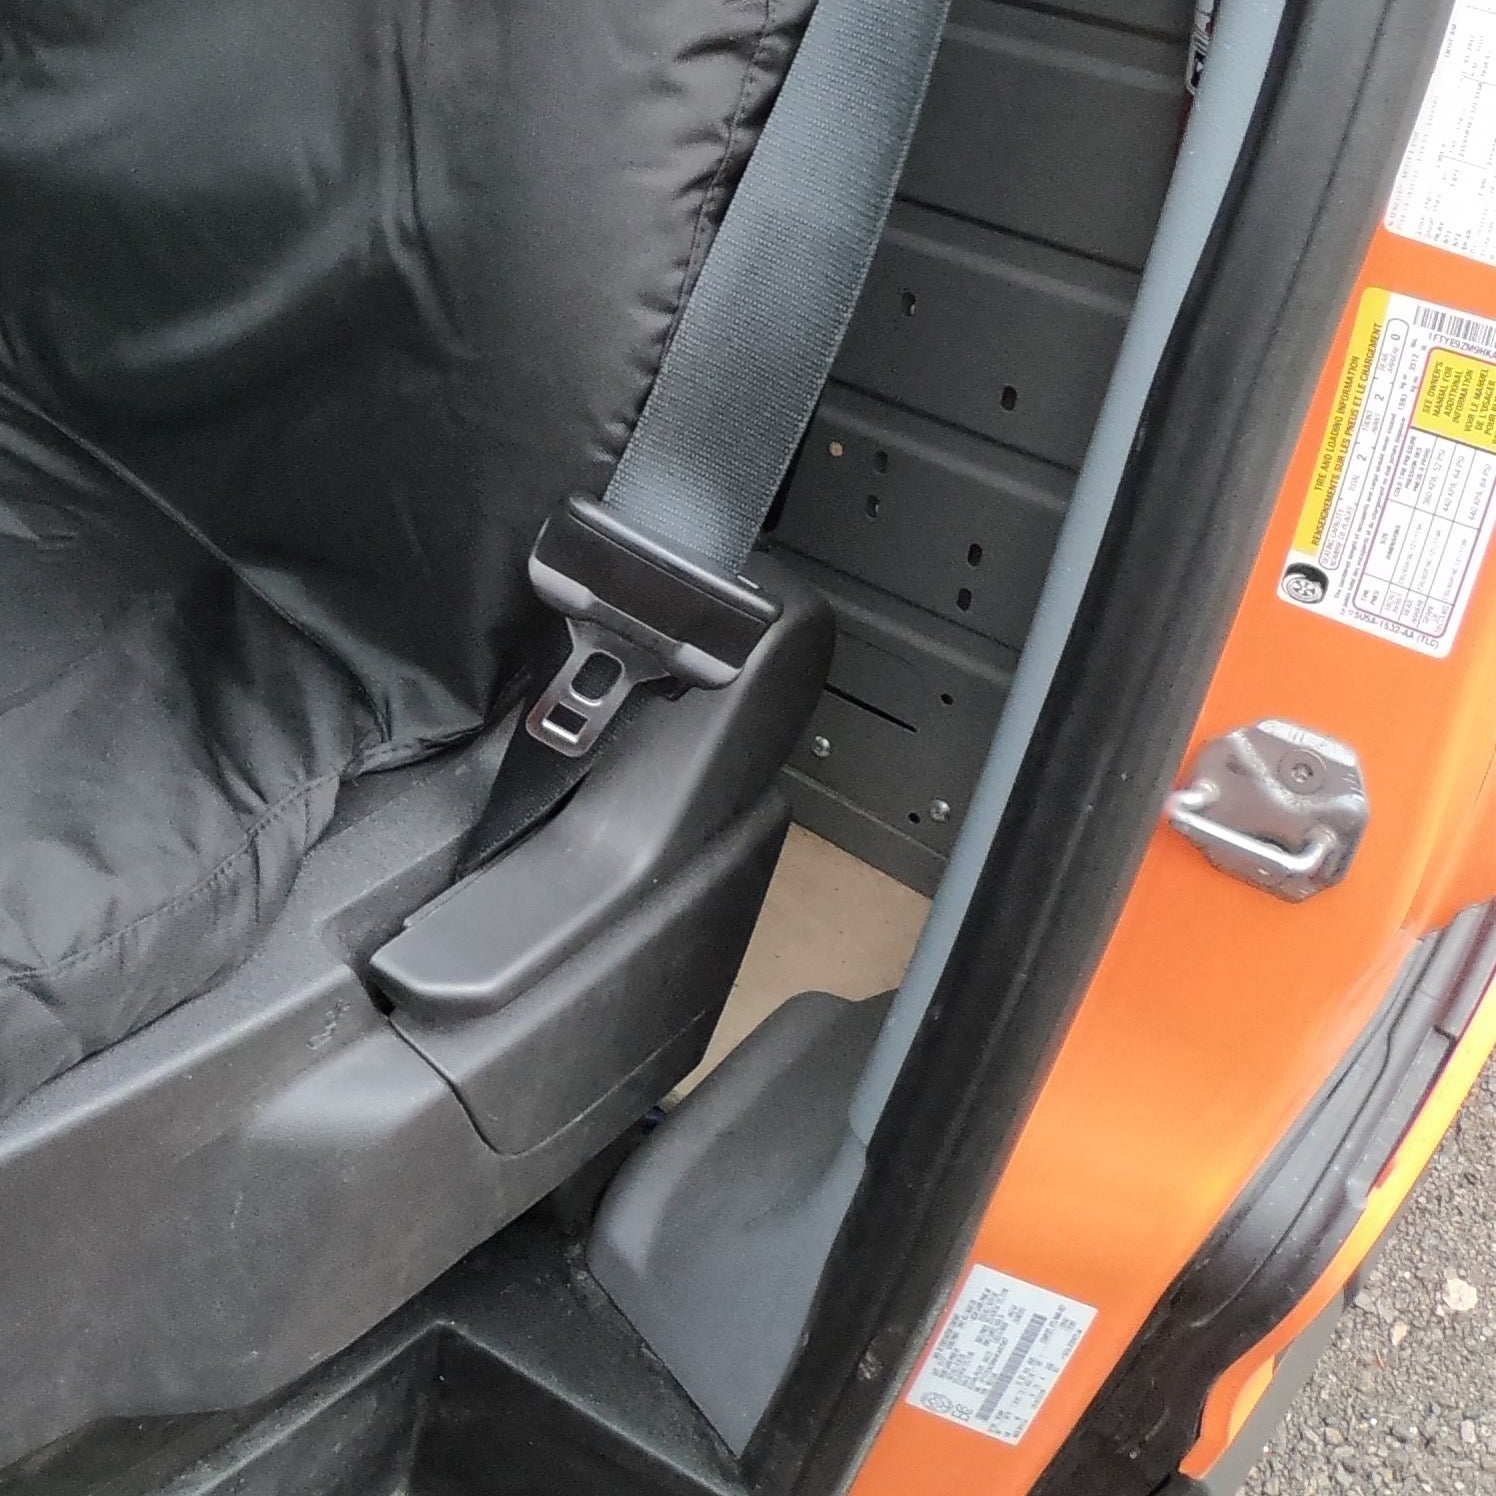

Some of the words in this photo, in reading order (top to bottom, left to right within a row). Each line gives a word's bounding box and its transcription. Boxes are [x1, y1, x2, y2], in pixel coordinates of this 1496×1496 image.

[1361, 322, 1382, 381] CHARGEMENT
[1337, 355, 1360, 414] INFORMATION
[1355, 381, 1366, 394] LE
[1431, 382, 1448, 417] MANUAL
[1441, 365, 1453, 382] FOR
[1442, 369, 1463, 416] ADDITIONAL
[1352, 395, 1362, 407] ET
[1374, 393, 1384, 401] 2
[1451, 368, 1473, 423] INFORMATION
[1421, 398, 1432, 414] SEE
[1469, 401, 1479, 412] LE
[1343, 407, 1359, 436] PNEUS
[1474, 420, 1484, 431] DE
[1325, 414, 1343, 452] LOADING
[1338, 436, 1351, 453] LES
[1320, 452, 1332, 471] AND
[1333, 454, 1345, 472] SUR
[1356, 453, 1366, 461] 2
[1314, 471, 1326, 491] TIRE
[1311, 472, 1340, 546] RENSEIGNEMENTS
